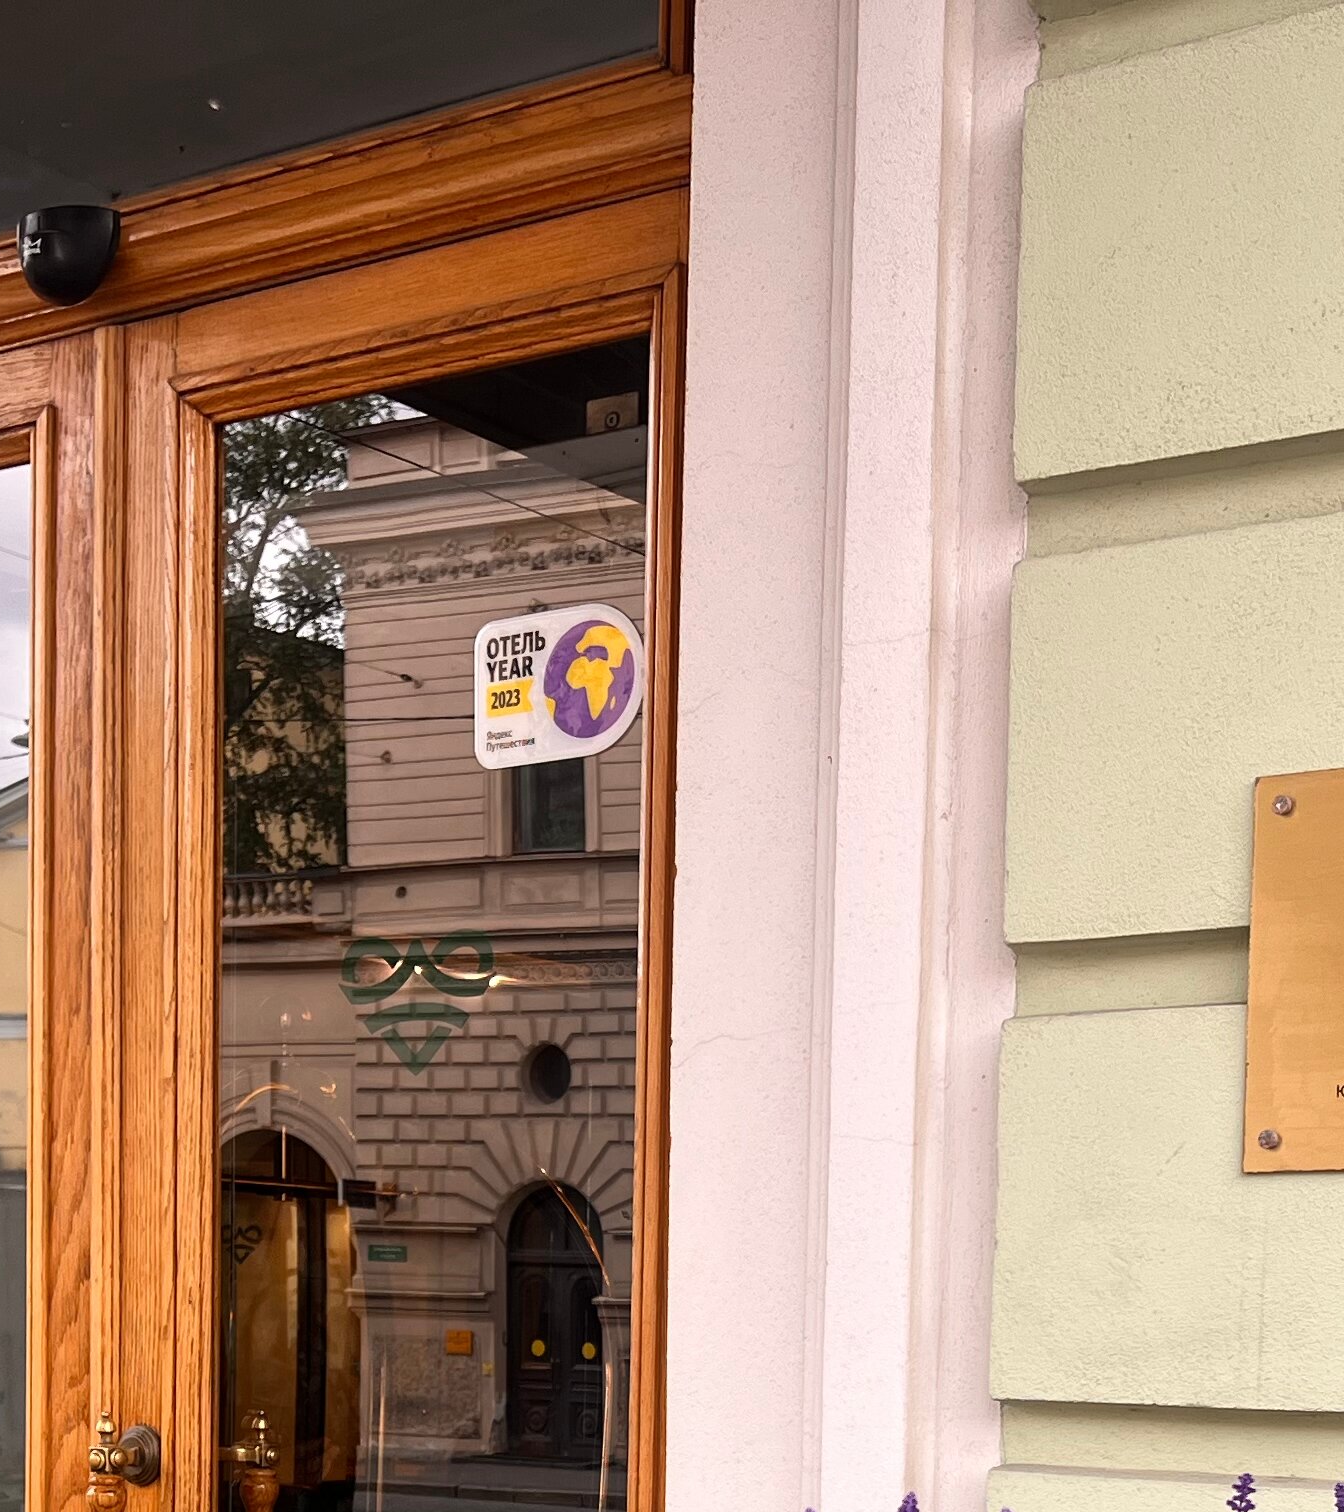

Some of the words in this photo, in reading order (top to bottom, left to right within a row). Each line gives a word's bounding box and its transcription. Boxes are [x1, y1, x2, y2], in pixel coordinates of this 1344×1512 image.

[486, 630, 546, 660] ОТЕЛЬ
[486, 655, 533, 682] YEAR
[490, 688, 521, 710] 2023
